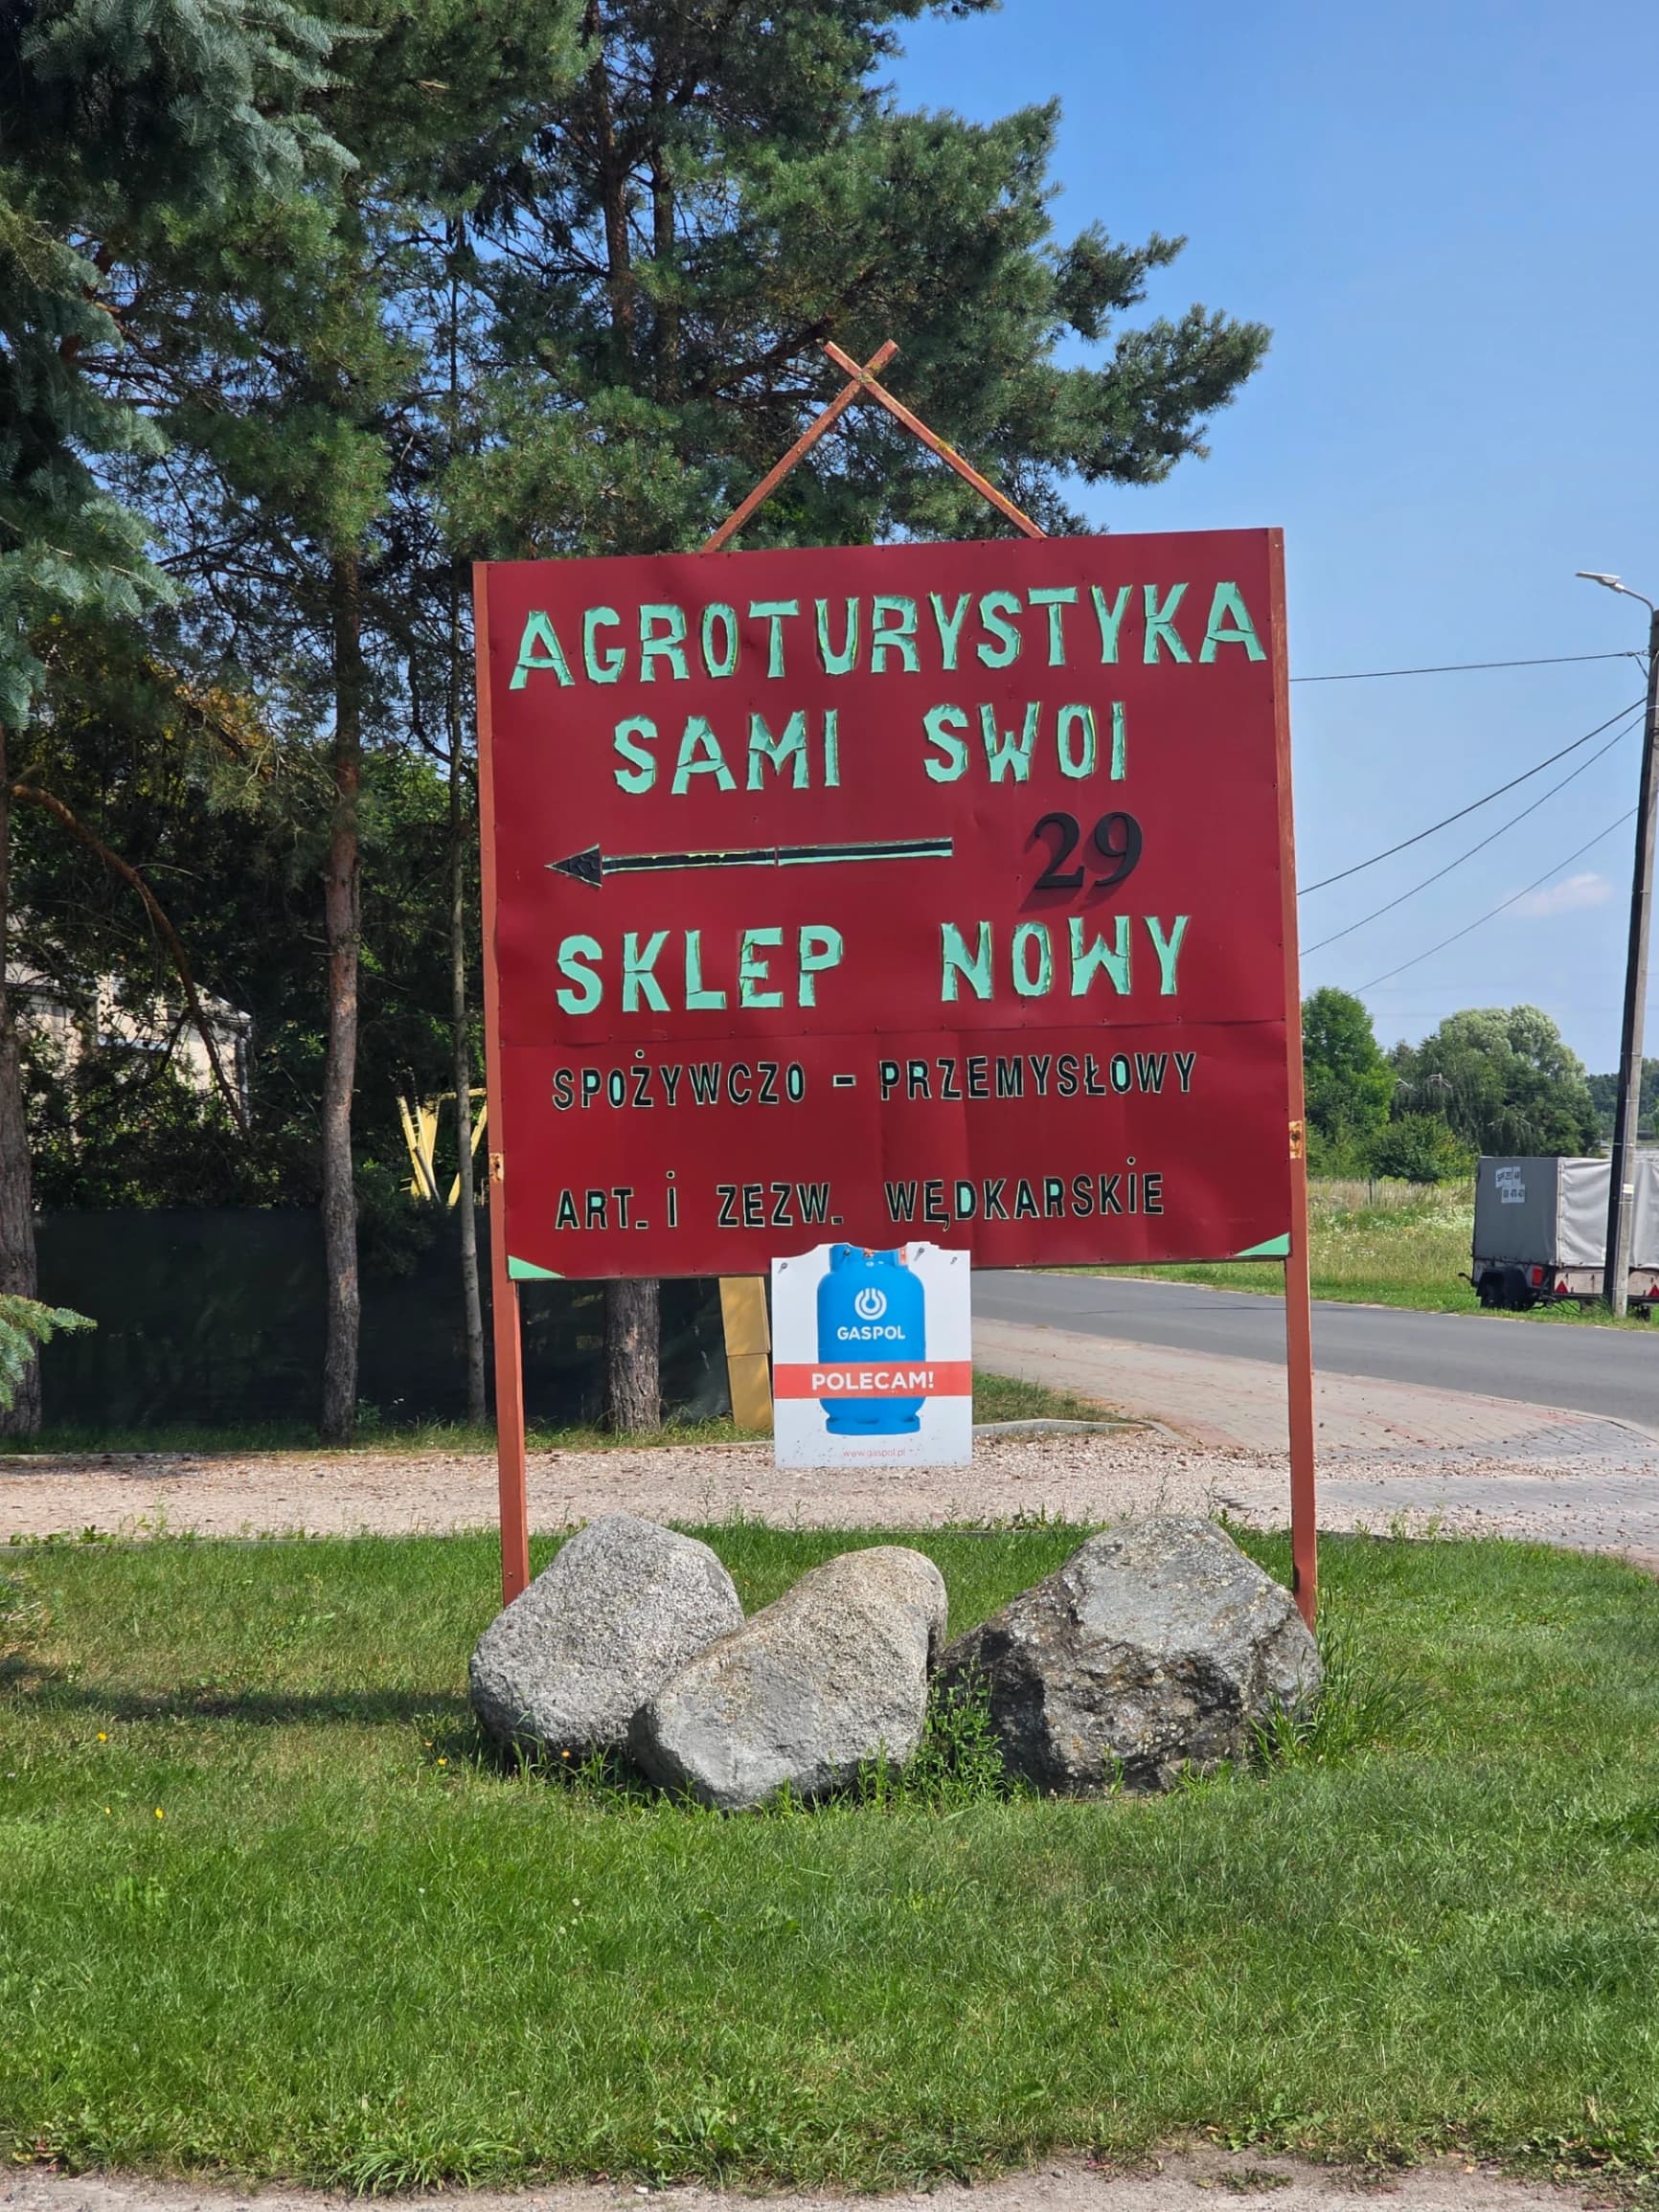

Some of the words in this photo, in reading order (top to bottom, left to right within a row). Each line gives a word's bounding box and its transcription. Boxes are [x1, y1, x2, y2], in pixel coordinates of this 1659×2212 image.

[509, 581, 1267, 690] AGROTURYSTYKA
[612, 709, 841, 795] SAMI
[921, 700, 1127, 783] SWOI
[1034, 811, 1143, 891] 29
[556, 924, 844, 1016] SKLEP
[940, 914, 1191, 1002] NOWY
[552, 1049, 806, 1111] SPOŻYWCZO
[879, 1051, 1195, 1101] PRZEMYSŁOWY
[555, 1186, 649, 1230] ART.
[716, 1182, 844, 1228] ZEZW.
[837, 1325, 906, 1341] GASPOL
[811, 1371, 935, 1390] POLECAM!
